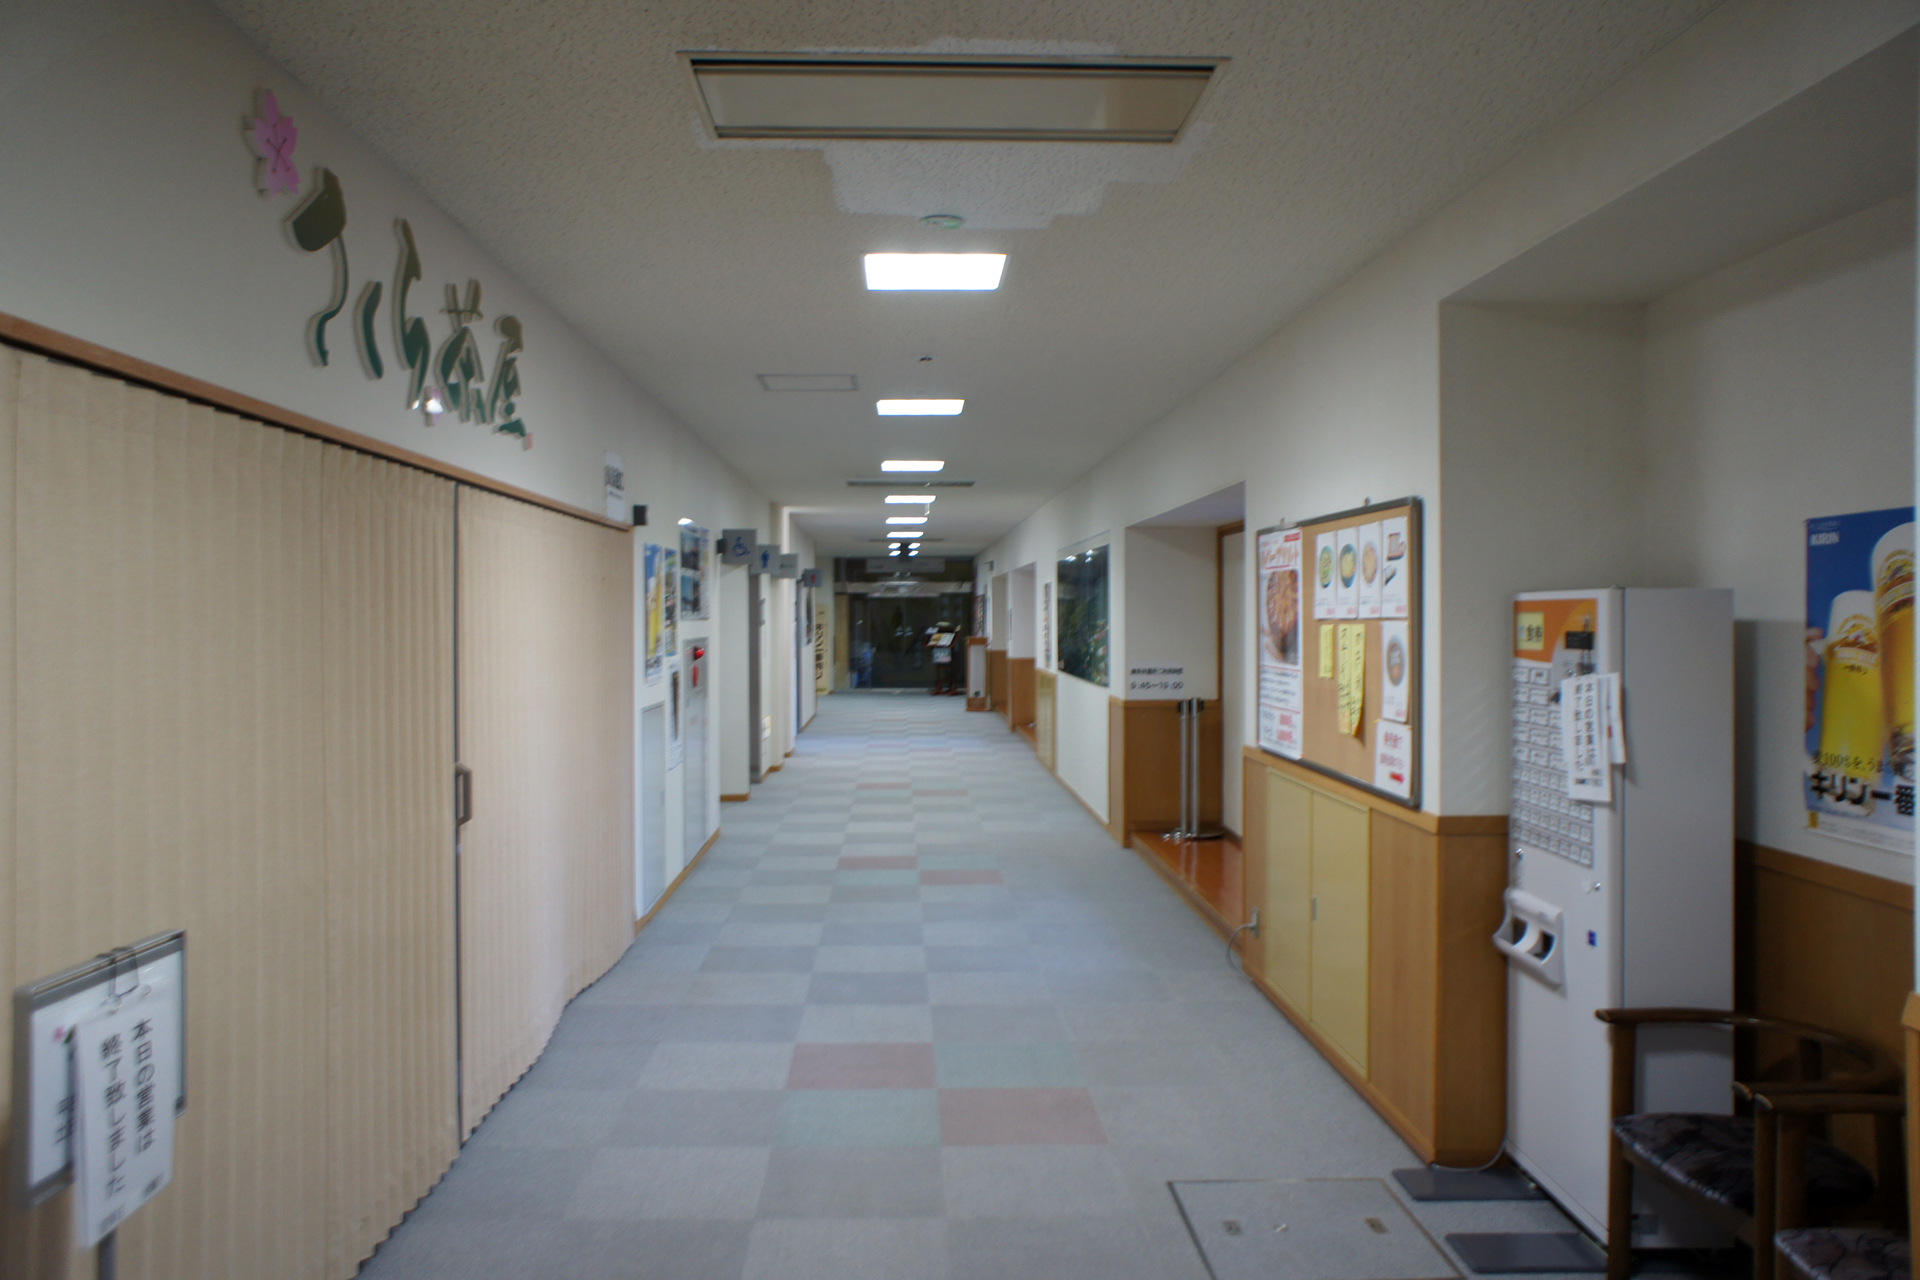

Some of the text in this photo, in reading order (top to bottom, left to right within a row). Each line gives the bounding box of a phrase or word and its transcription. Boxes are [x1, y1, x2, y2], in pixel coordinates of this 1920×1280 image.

[1811, 531, 1840, 546] KIRIN
[101, 1033, 127, 1198] 終了致しました
[132, 1018, 156, 1154] 本日の営業は
